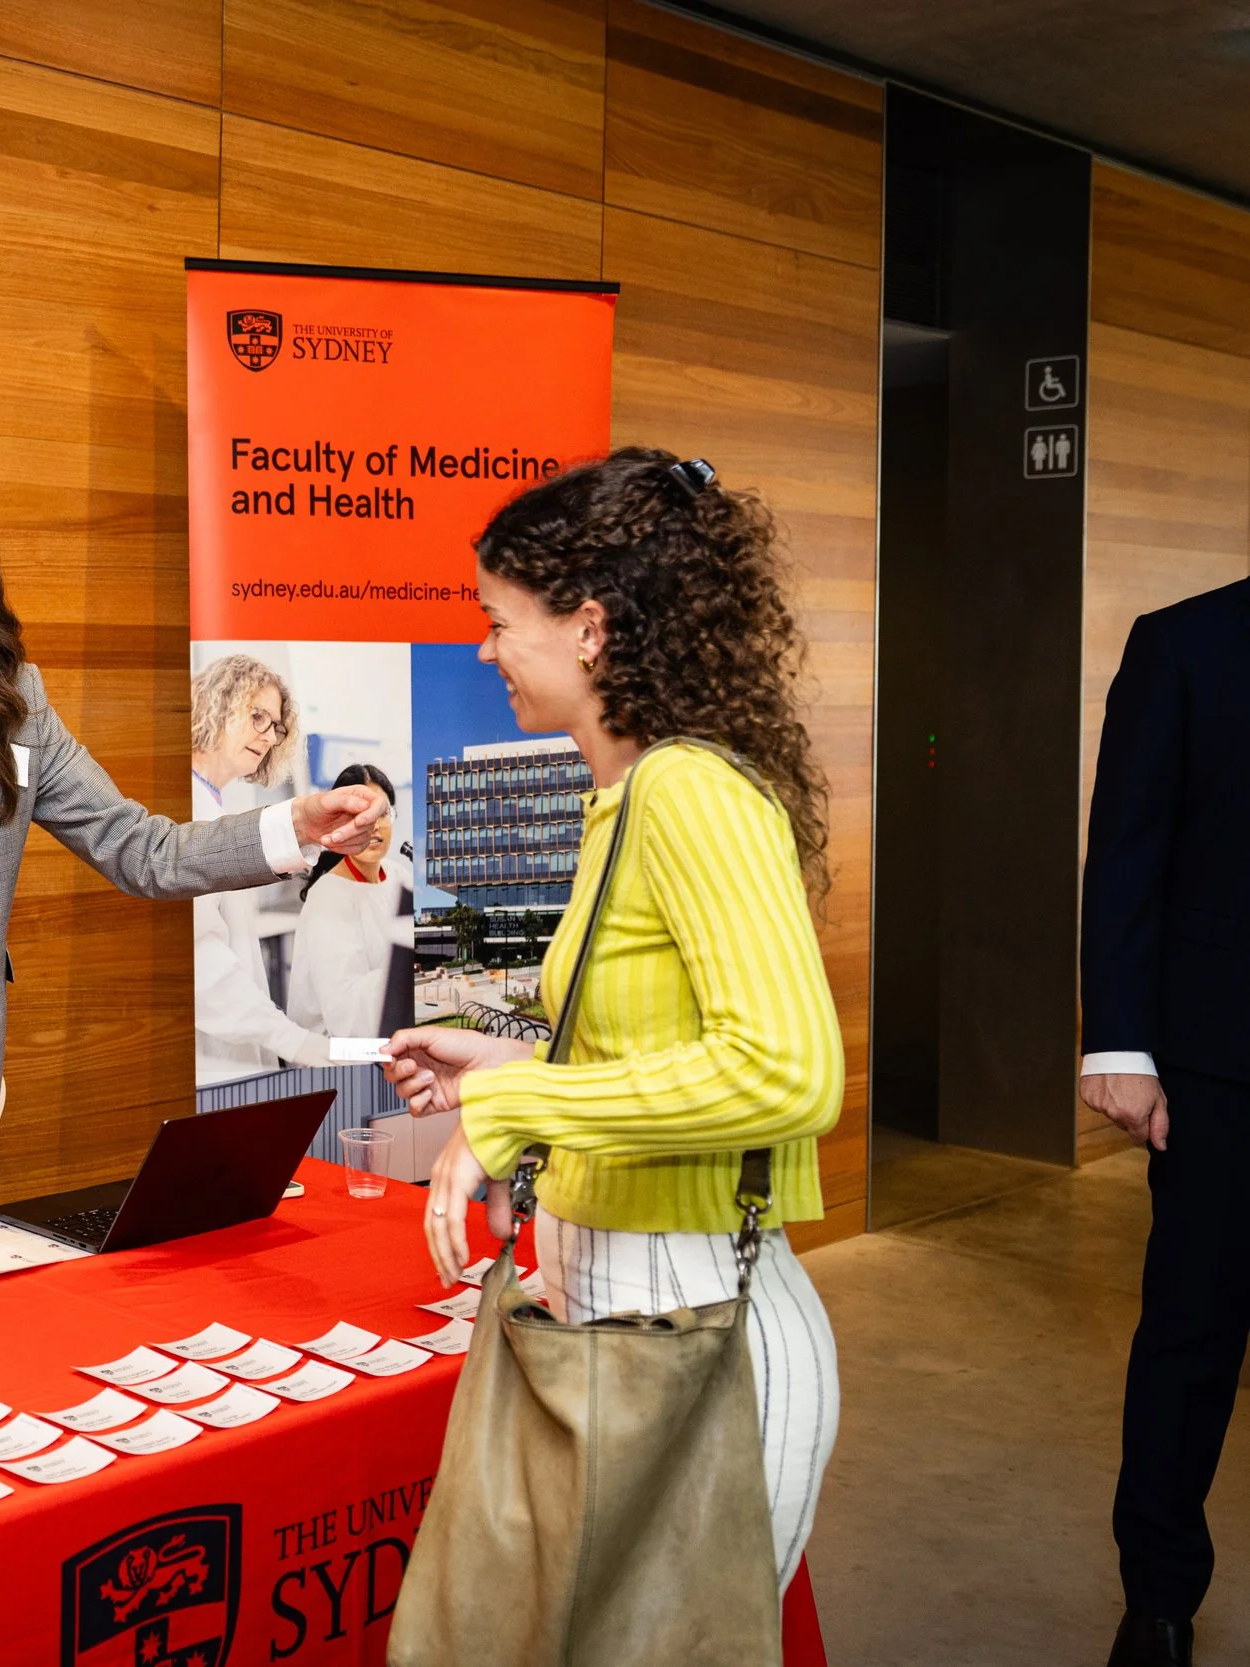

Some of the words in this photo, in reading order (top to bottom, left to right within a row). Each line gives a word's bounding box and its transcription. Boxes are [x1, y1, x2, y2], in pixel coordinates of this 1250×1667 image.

[293, 324, 314, 335] THE
[318, 326, 380, 338] UNIVERSITY
[381, 330, 393, 339] OF
[293, 337, 393, 364] SYDNEY
[231, 438, 355, 484] Faculty
[365, 444, 398, 477] of
[410, 446, 559, 481] Medicine
[231, 484, 295, 516] and
[310, 485, 415, 520] Health
[274, 1509, 338, 1562] THE
[346, 1478, 434, 1536] UNIVE
[270, 1530, 417, 1662] SYD
